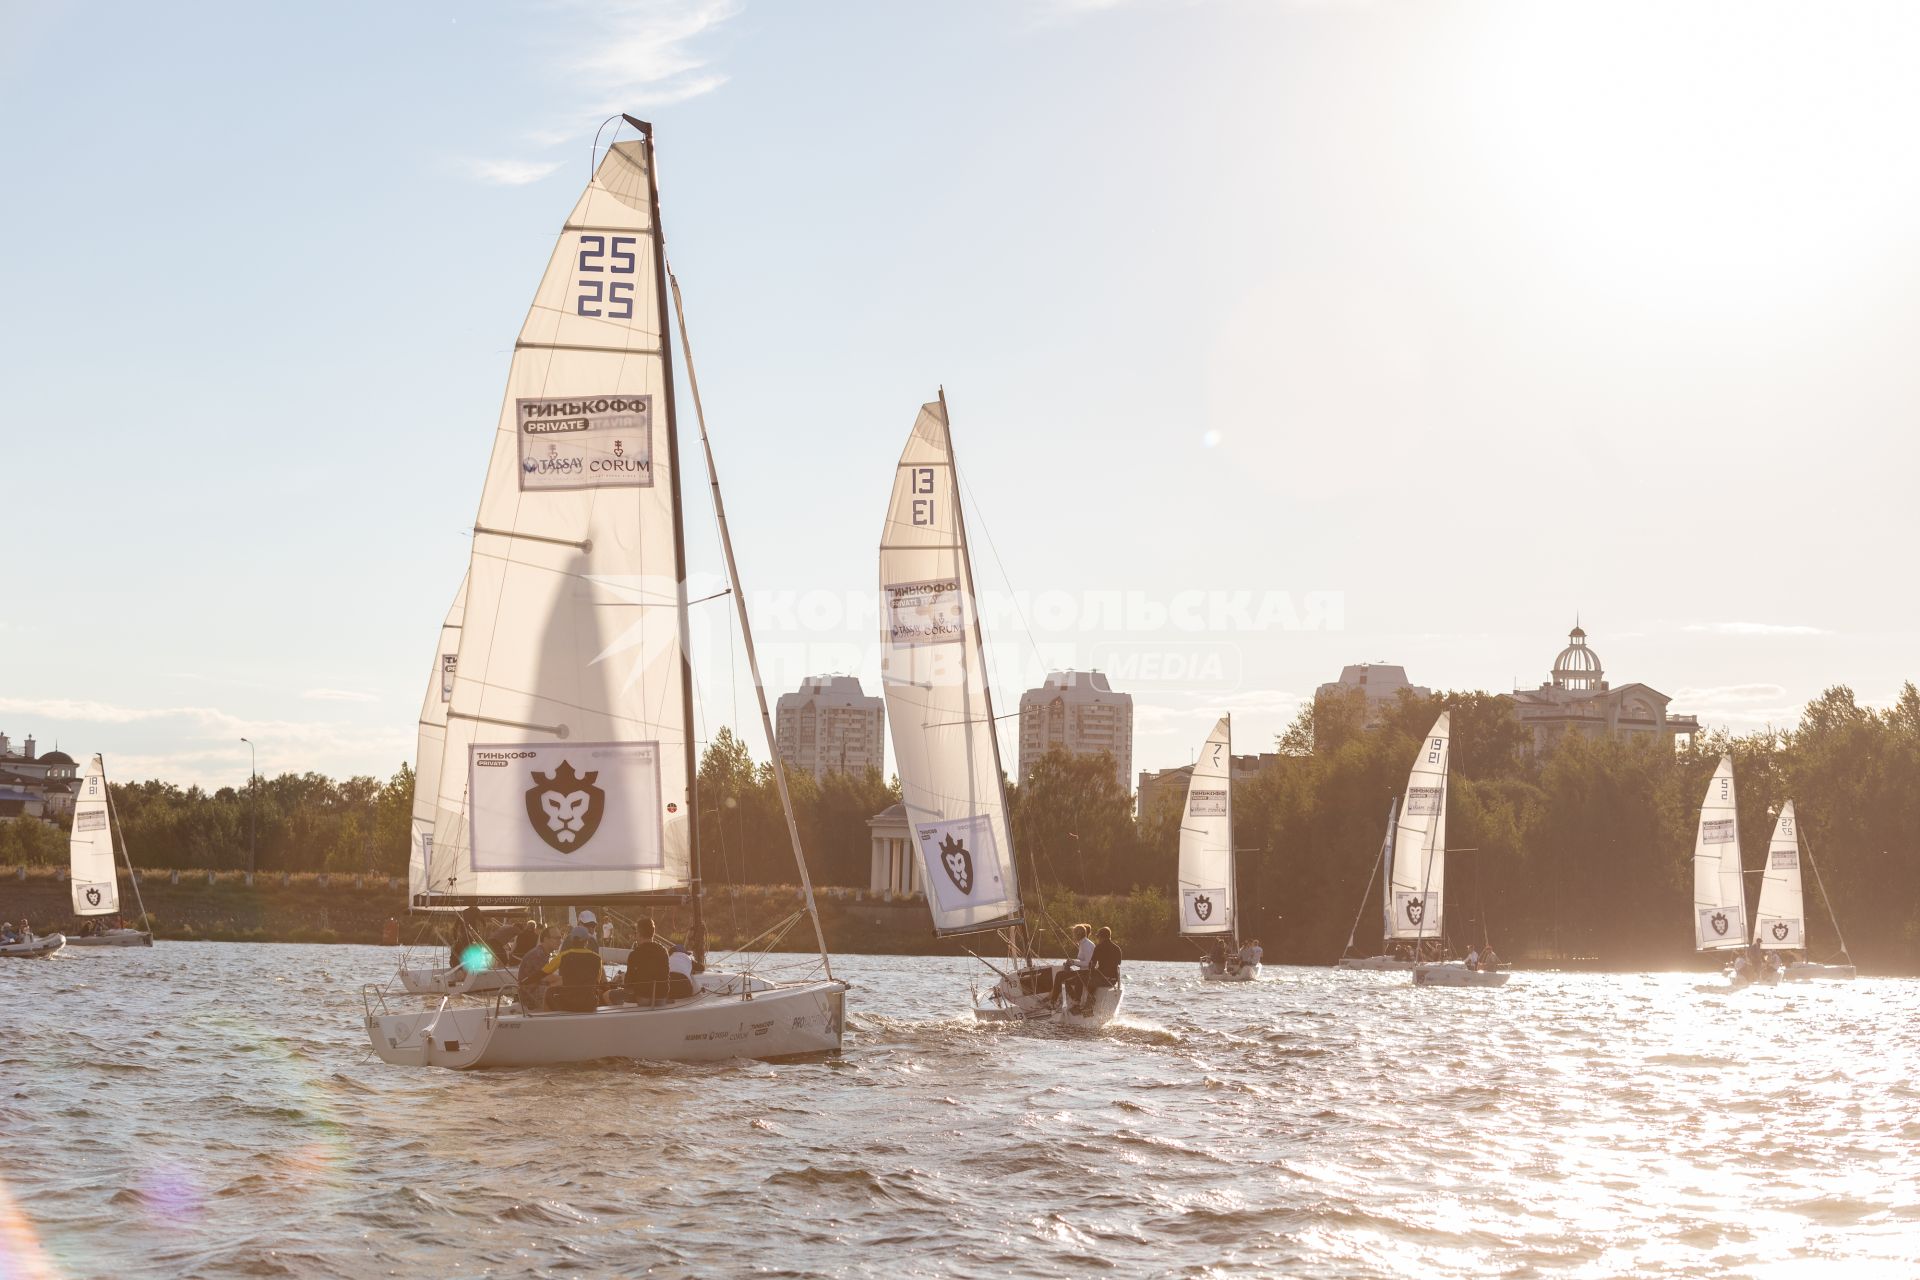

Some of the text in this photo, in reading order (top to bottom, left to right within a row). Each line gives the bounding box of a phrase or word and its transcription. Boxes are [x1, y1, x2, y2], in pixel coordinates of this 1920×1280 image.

[580, 236, 636, 273] 25
[523, 399, 647, 418] ТИНЬКОФФ
[527, 420, 585, 432] PRIVATE
[539, 457, 649, 473] TASSAY CORUM
[912, 468, 934, 494] 13
[888, 583, 957, 597] ТИНЬКОФФ
[1214, 743, 1222, 755] 7
[1430, 738, 1442, 750] 19
[1721, 778, 1728, 788] 5
[1781, 818, 1792, 827] 27
[1013, 1012, 1024, 1020] 13
